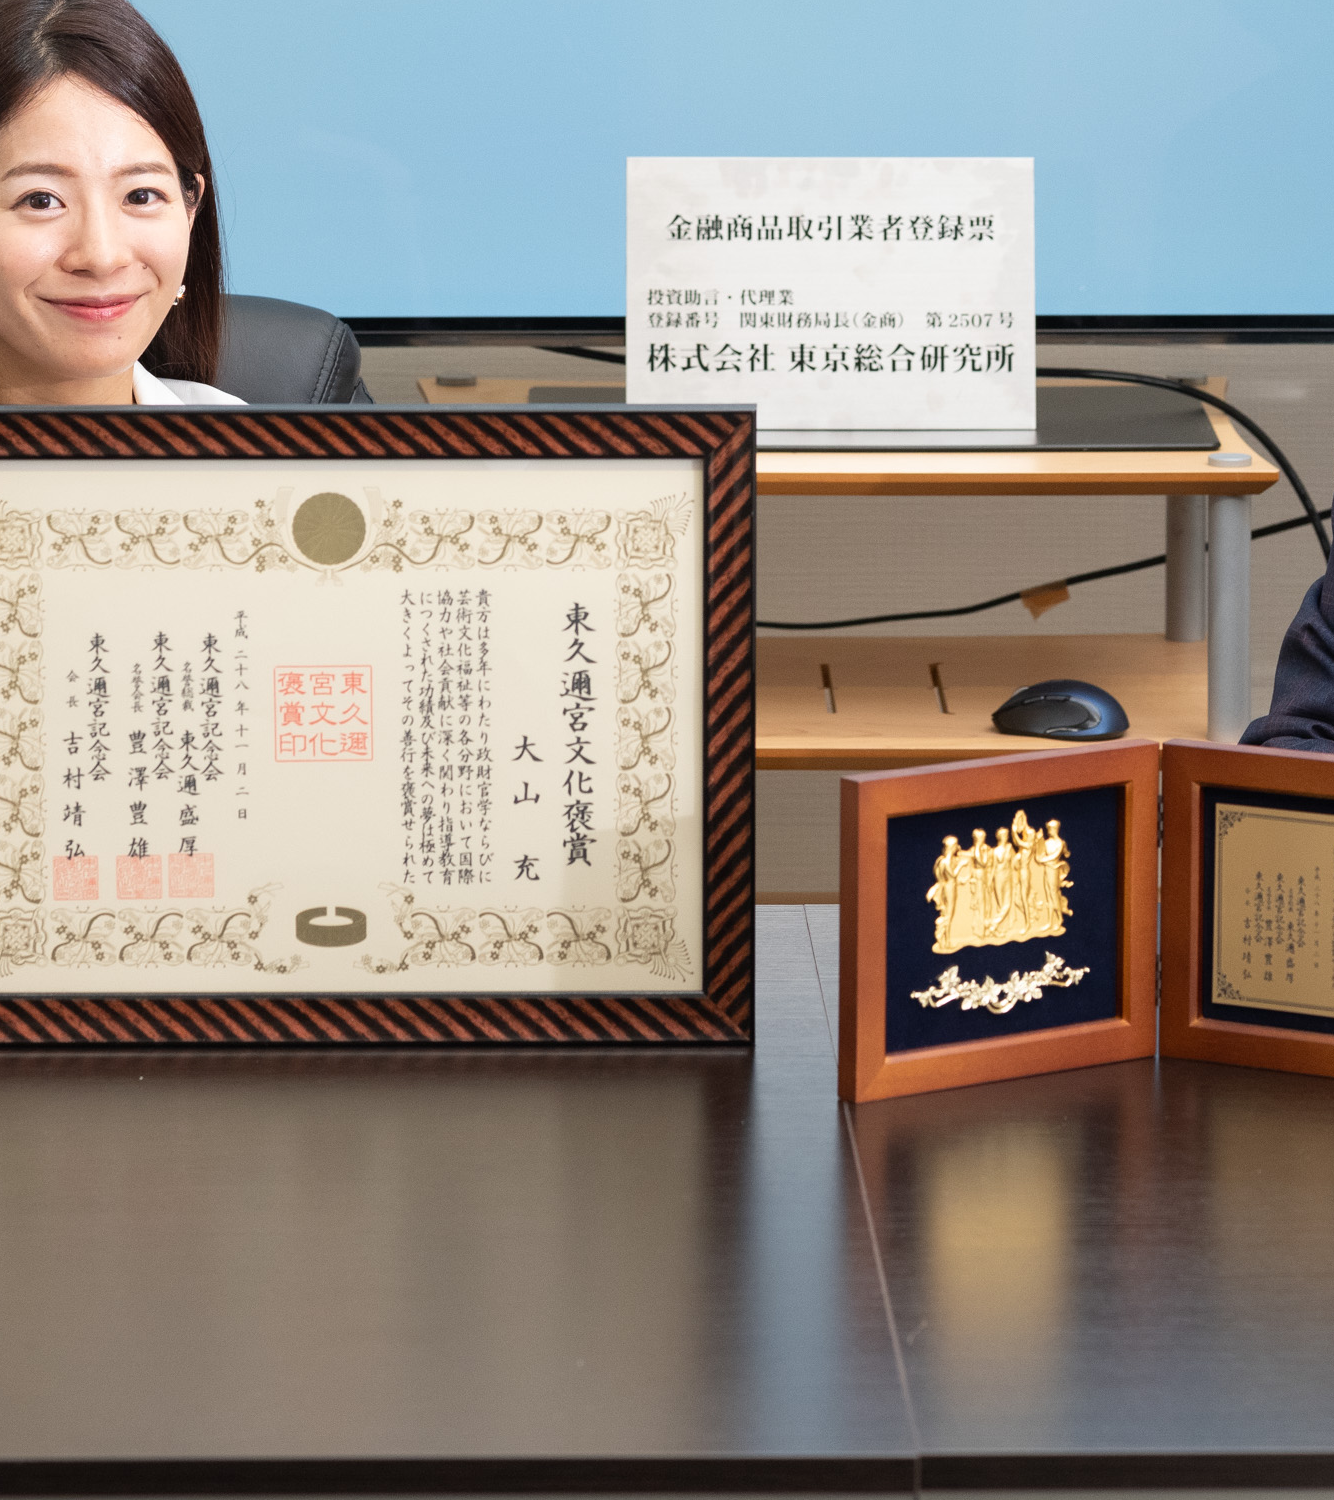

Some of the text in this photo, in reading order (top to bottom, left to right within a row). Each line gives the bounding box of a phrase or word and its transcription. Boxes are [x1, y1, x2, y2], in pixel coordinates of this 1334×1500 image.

[647, 288, 794, 306] 投資助言・代理業
[667, 213, 994, 241] 金融商品取引業者登録票
[647, 343, 1015, 373] 株式会社 東京総合研究所
[648, 311, 719, 329] 登録番号
[926, 311, 1015, 329] 第2507号
[87, 632, 112, 782] 東久邇宮記念会
[150, 631, 175, 781] 東久邇宮記念会
[199, 632, 225, 782] 東久邇宮記念会
[400, 589, 417, 885] 大きくよってその善行を褒賞せられた
[419, 591, 436, 884] につくされた功績及び未来への夢は極めて
[437, 589, 455, 885] 協力や社会貢献に深く関わり指導教育
[456, 589, 474, 885] 芸術文化福祉等の各分野において国際
[476, 588, 493, 883] 貴方は多年にわたり政財官学ならびに
[560, 601, 598, 868] 東久邇宮文化褒賞
